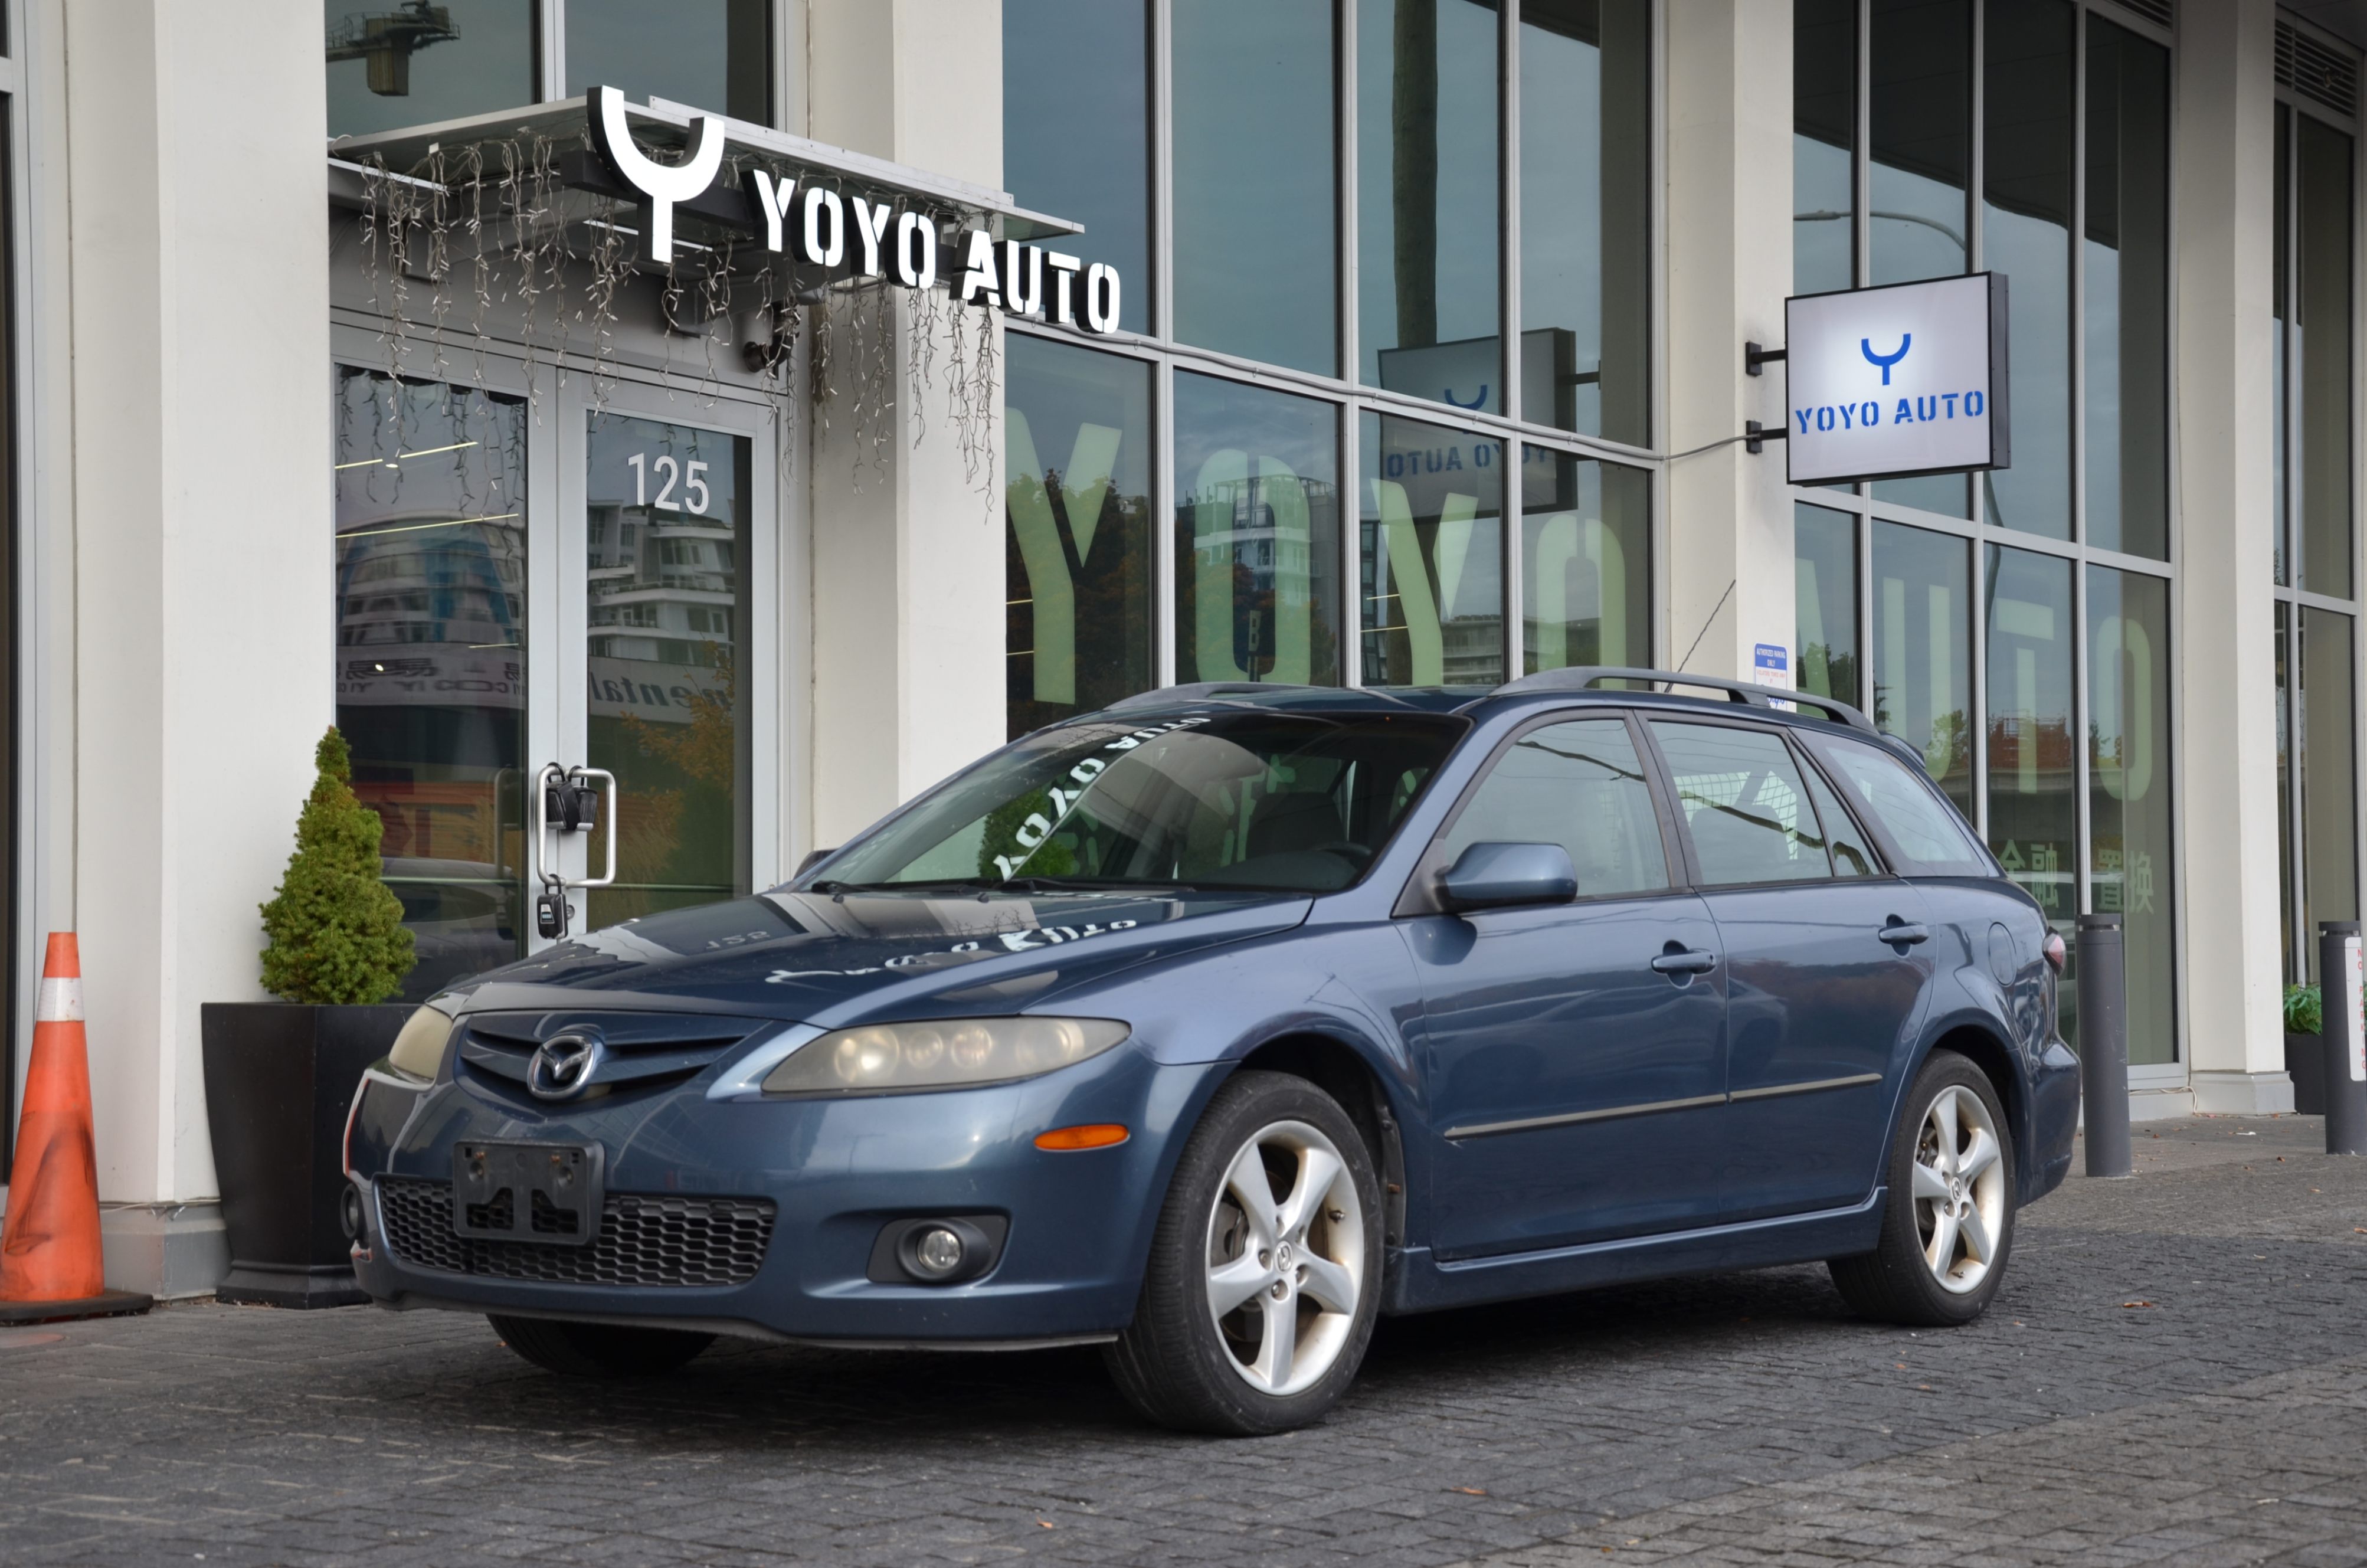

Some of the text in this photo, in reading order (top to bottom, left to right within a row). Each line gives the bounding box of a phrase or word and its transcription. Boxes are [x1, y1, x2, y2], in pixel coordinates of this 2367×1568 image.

[751, 168, 1122, 335] YOYO AUTO
[1795, 390, 1984, 435] YOYO AUTO
[627, 452, 709, 515] 125
[1005, 405, 1626, 704] YOYO
